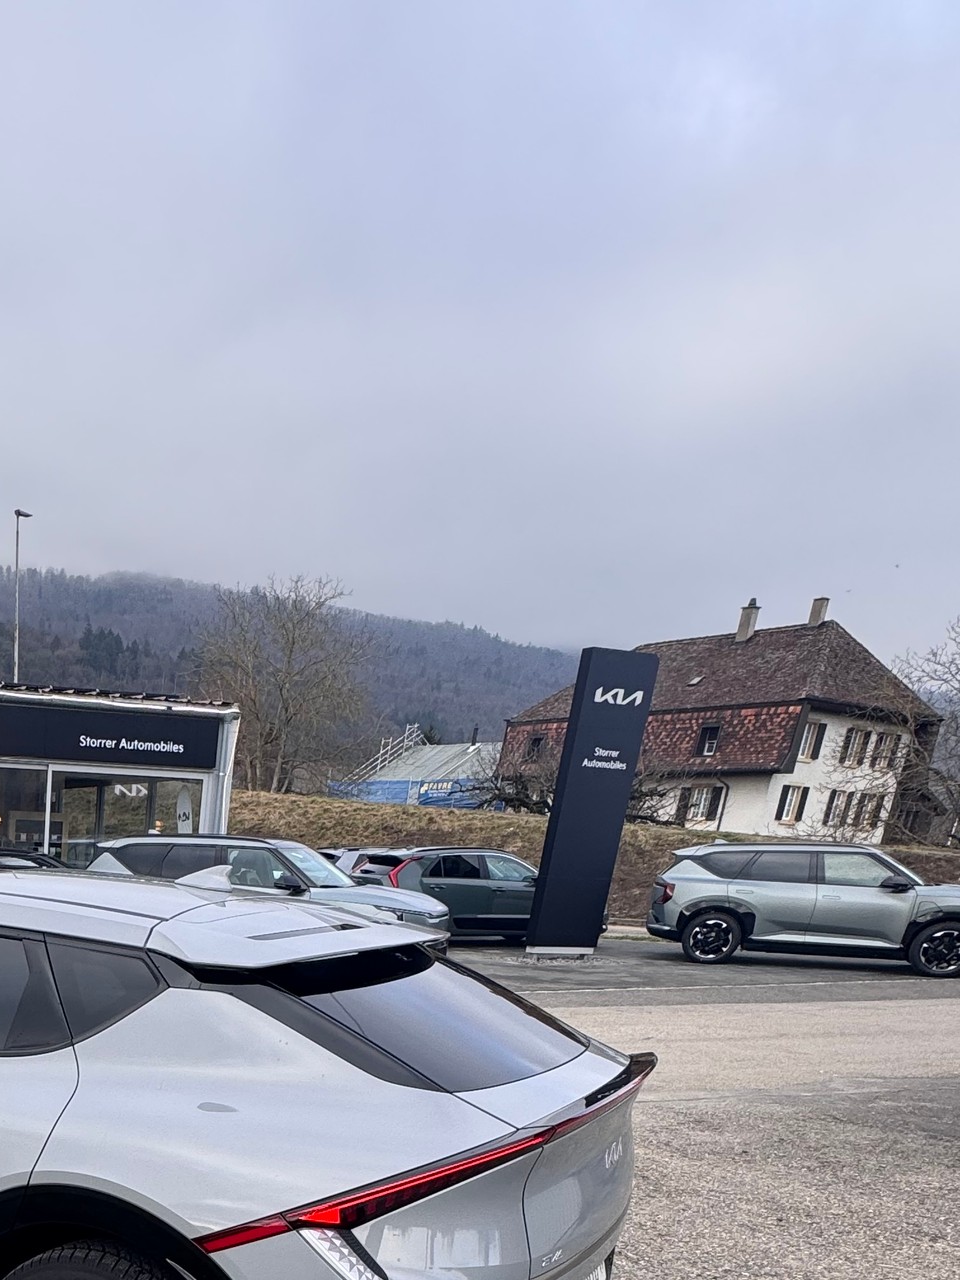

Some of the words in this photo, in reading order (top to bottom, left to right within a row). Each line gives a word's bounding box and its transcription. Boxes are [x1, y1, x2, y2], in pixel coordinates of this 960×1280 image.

[594, 686, 644, 707] KIA
[79, 735, 117, 749] Storrer
[119, 738, 185, 753] Automobiles
[594, 747, 620, 757] Storrer
[582, 758, 627, 770] Automobiles
